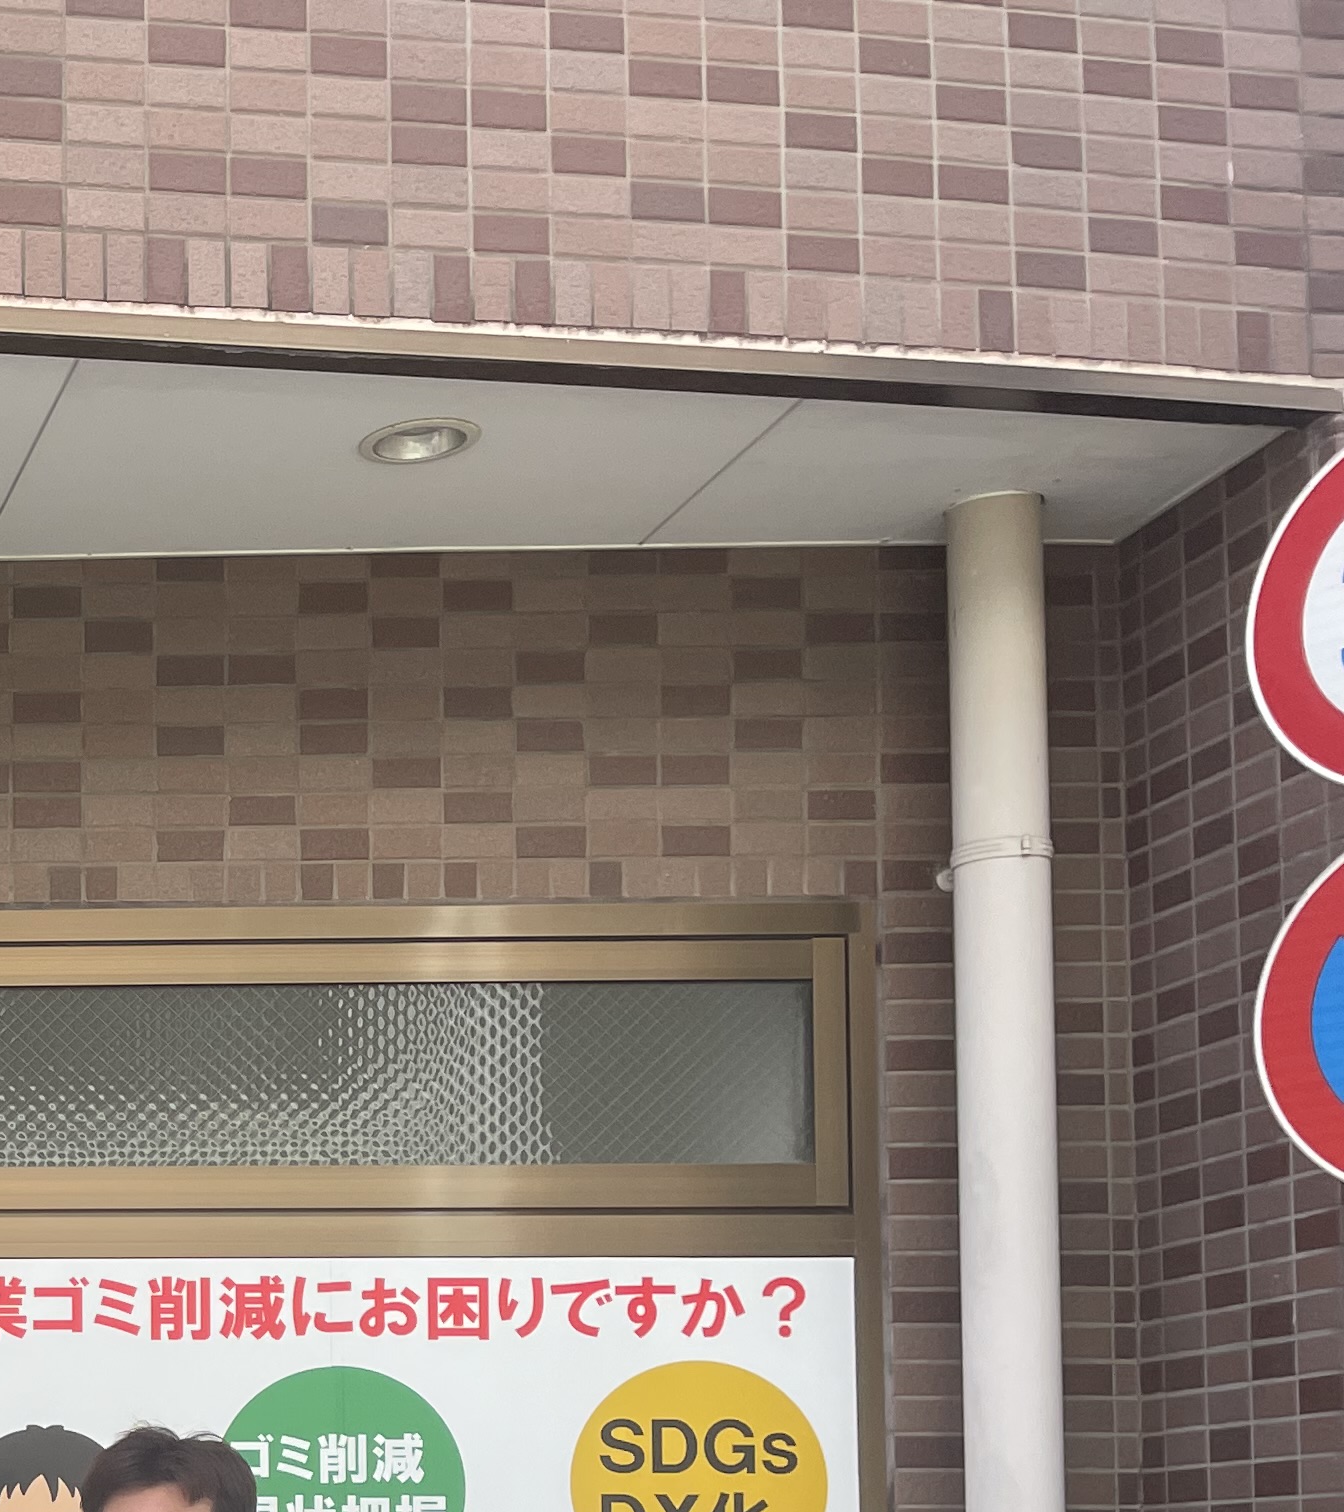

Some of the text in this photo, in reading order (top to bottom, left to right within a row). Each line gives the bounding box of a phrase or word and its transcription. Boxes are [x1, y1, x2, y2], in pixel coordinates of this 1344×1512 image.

[229, 1432, 425, 1485] ゴミ削減
[598, 1418, 799, 1475] SDGs
